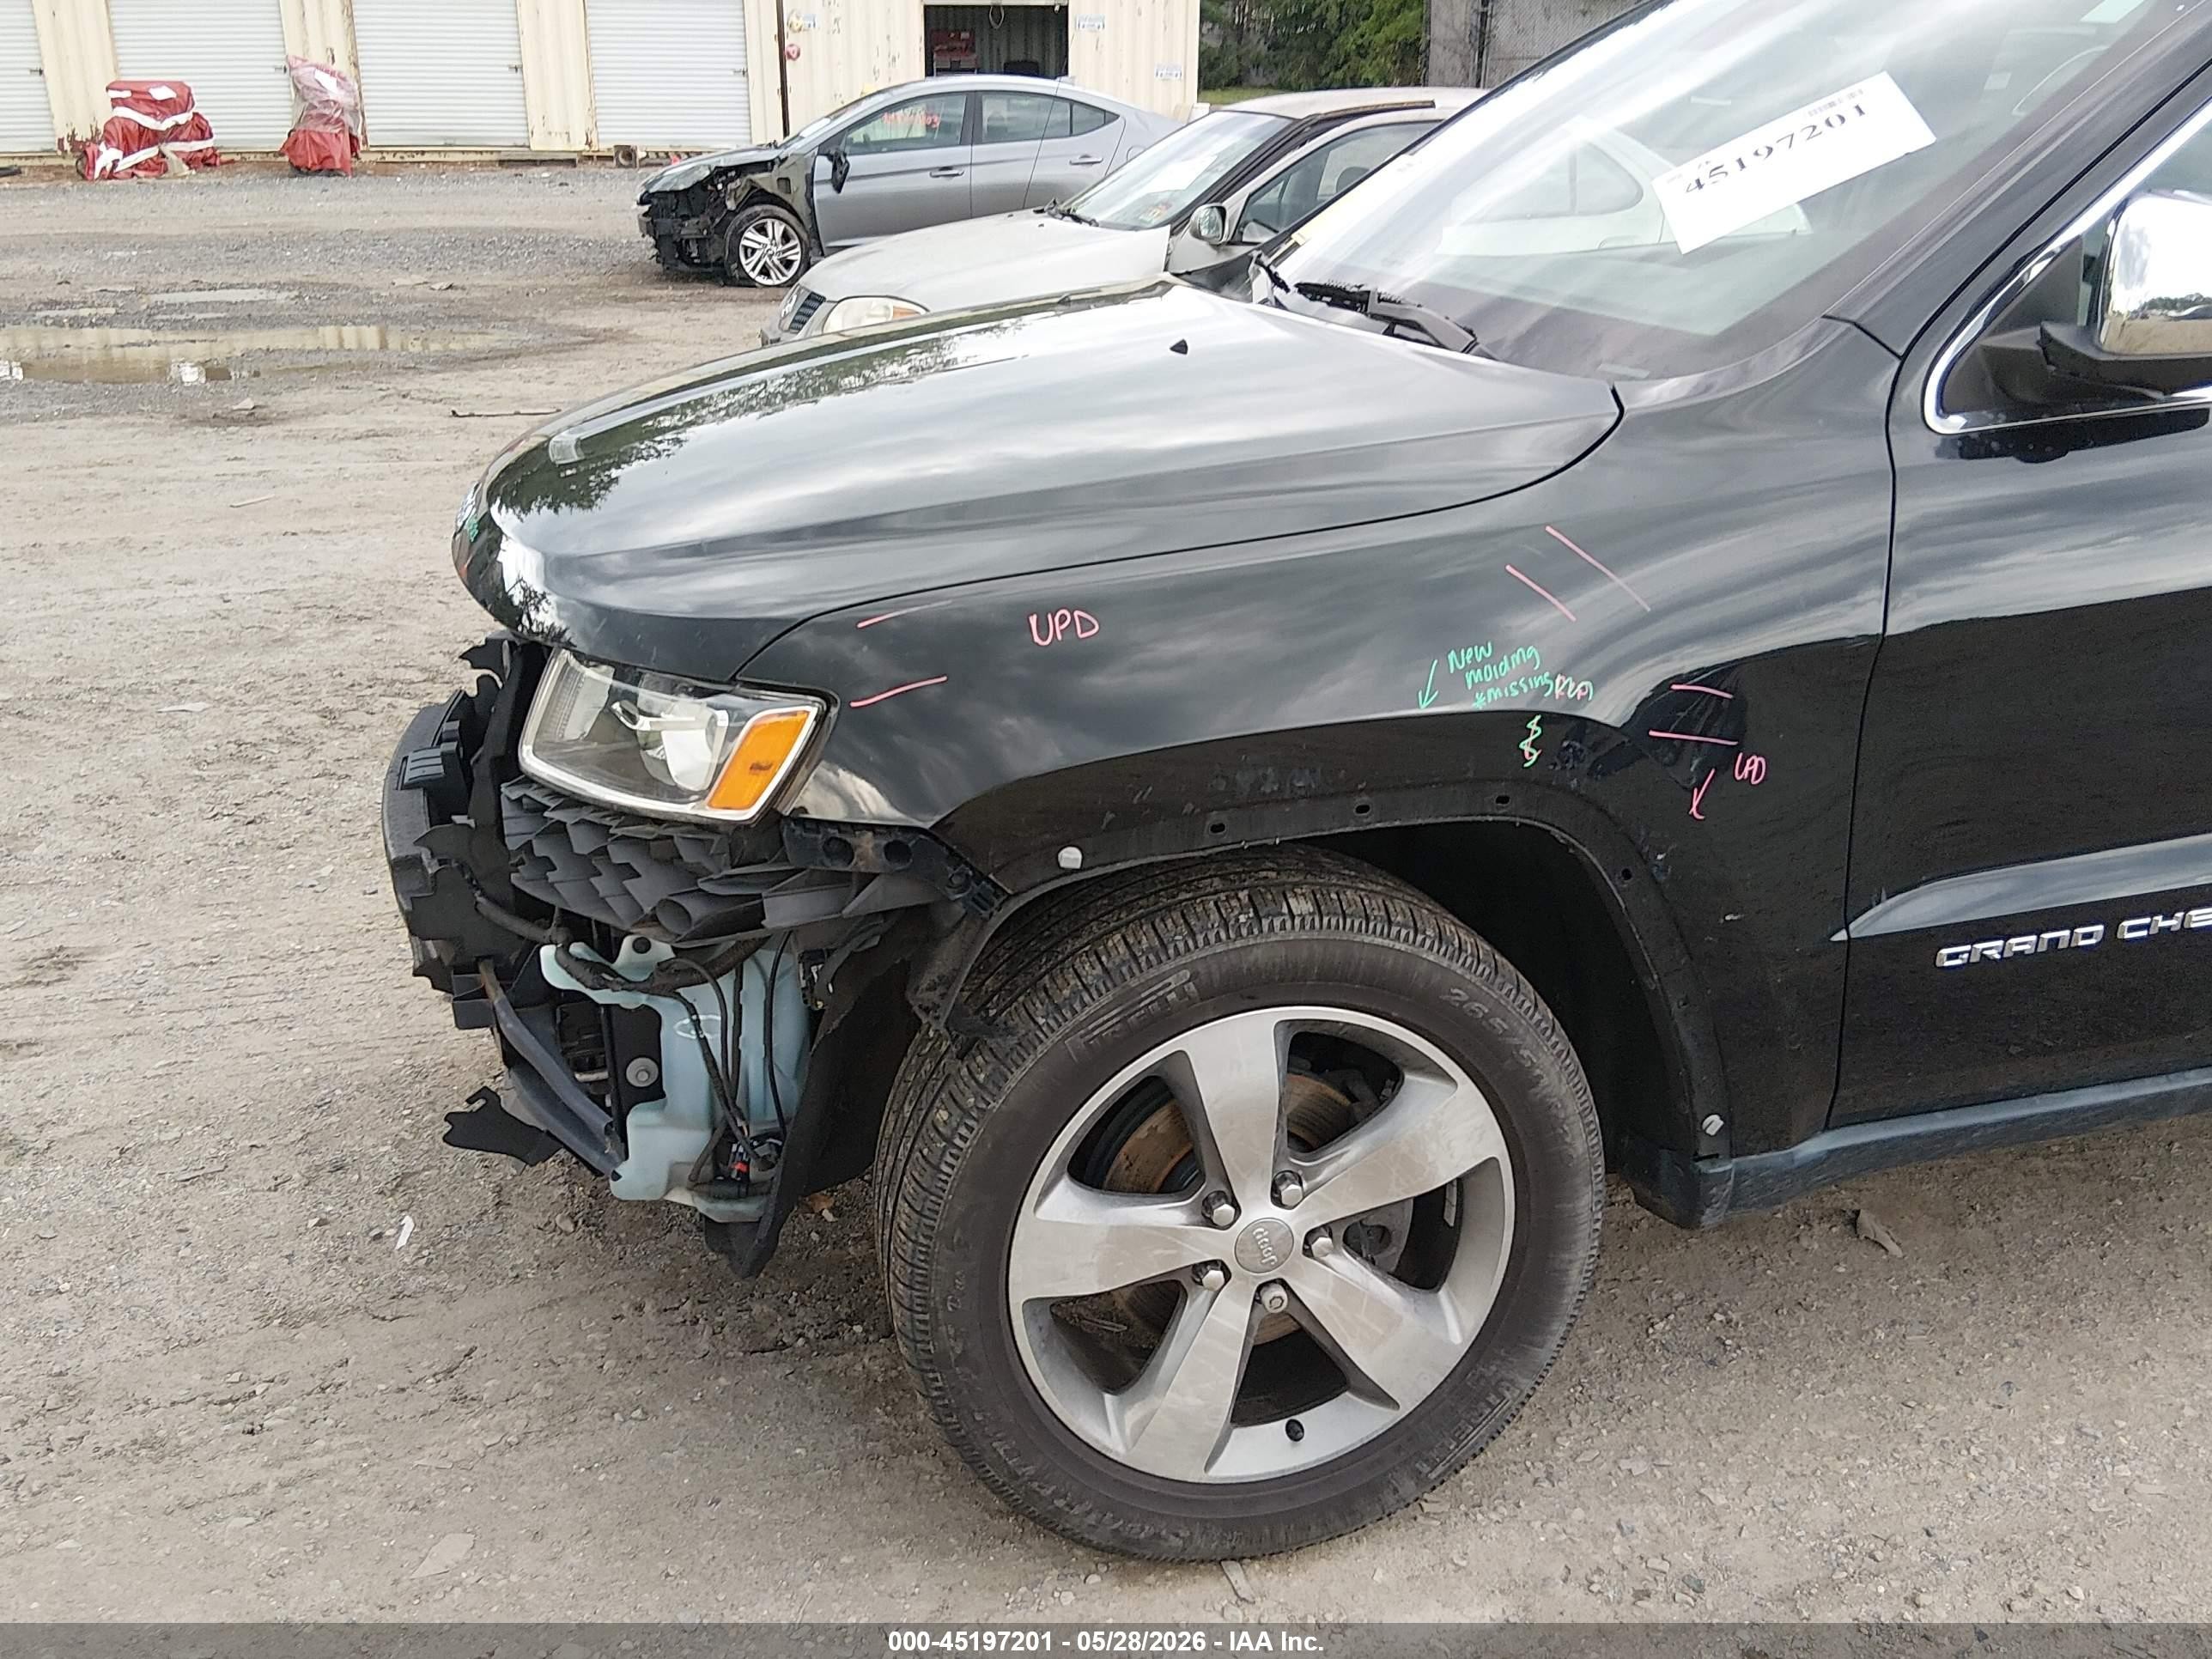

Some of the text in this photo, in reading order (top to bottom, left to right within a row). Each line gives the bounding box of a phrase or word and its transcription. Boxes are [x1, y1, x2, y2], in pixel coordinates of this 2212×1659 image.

[1686, 104, 1866, 193] 45197201
[1030, 609, 1100, 646] UPD
[1448, 641, 1492, 673] New
[1936, 908, 2212, 968] GRAND CHE
[1253, 1228, 1278, 1265] Jeep
